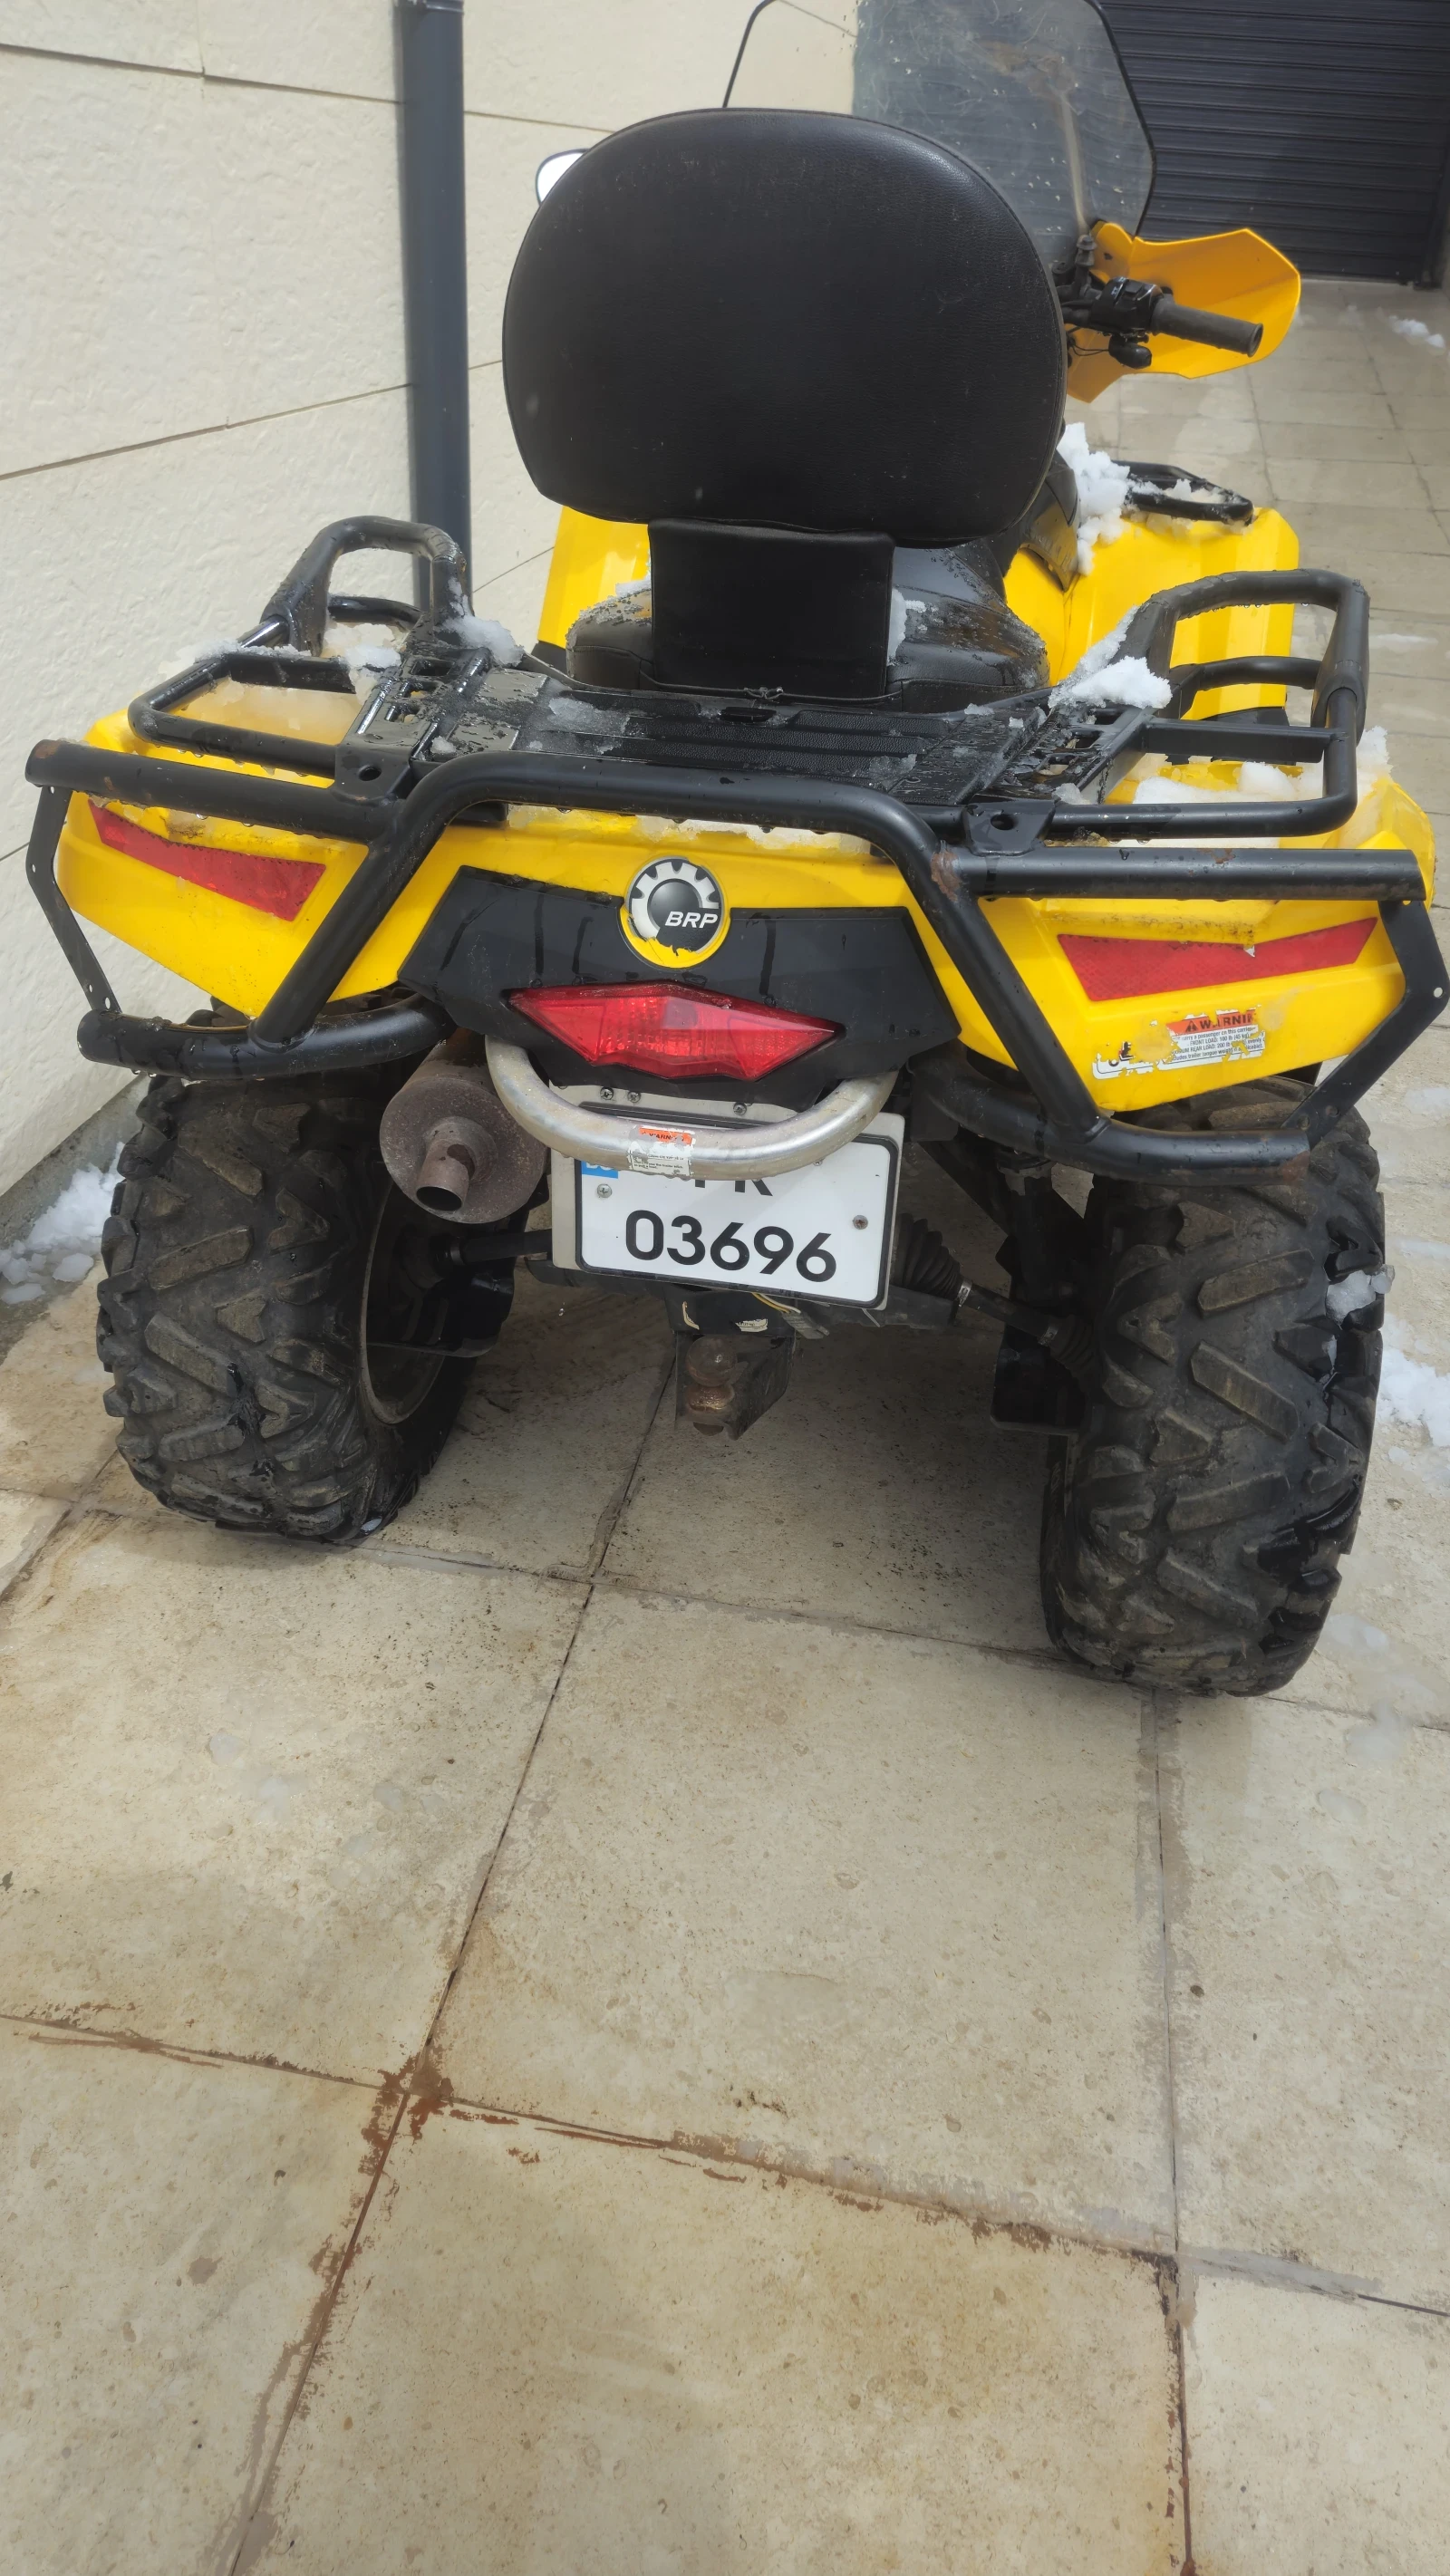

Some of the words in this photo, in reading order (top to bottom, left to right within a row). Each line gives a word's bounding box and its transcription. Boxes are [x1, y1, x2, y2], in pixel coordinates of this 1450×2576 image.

[664, 911, 718, 929] BRP
[1197, 1031, 1221, 1040] passenger
[625, 1209, 837, 1283] 03696
